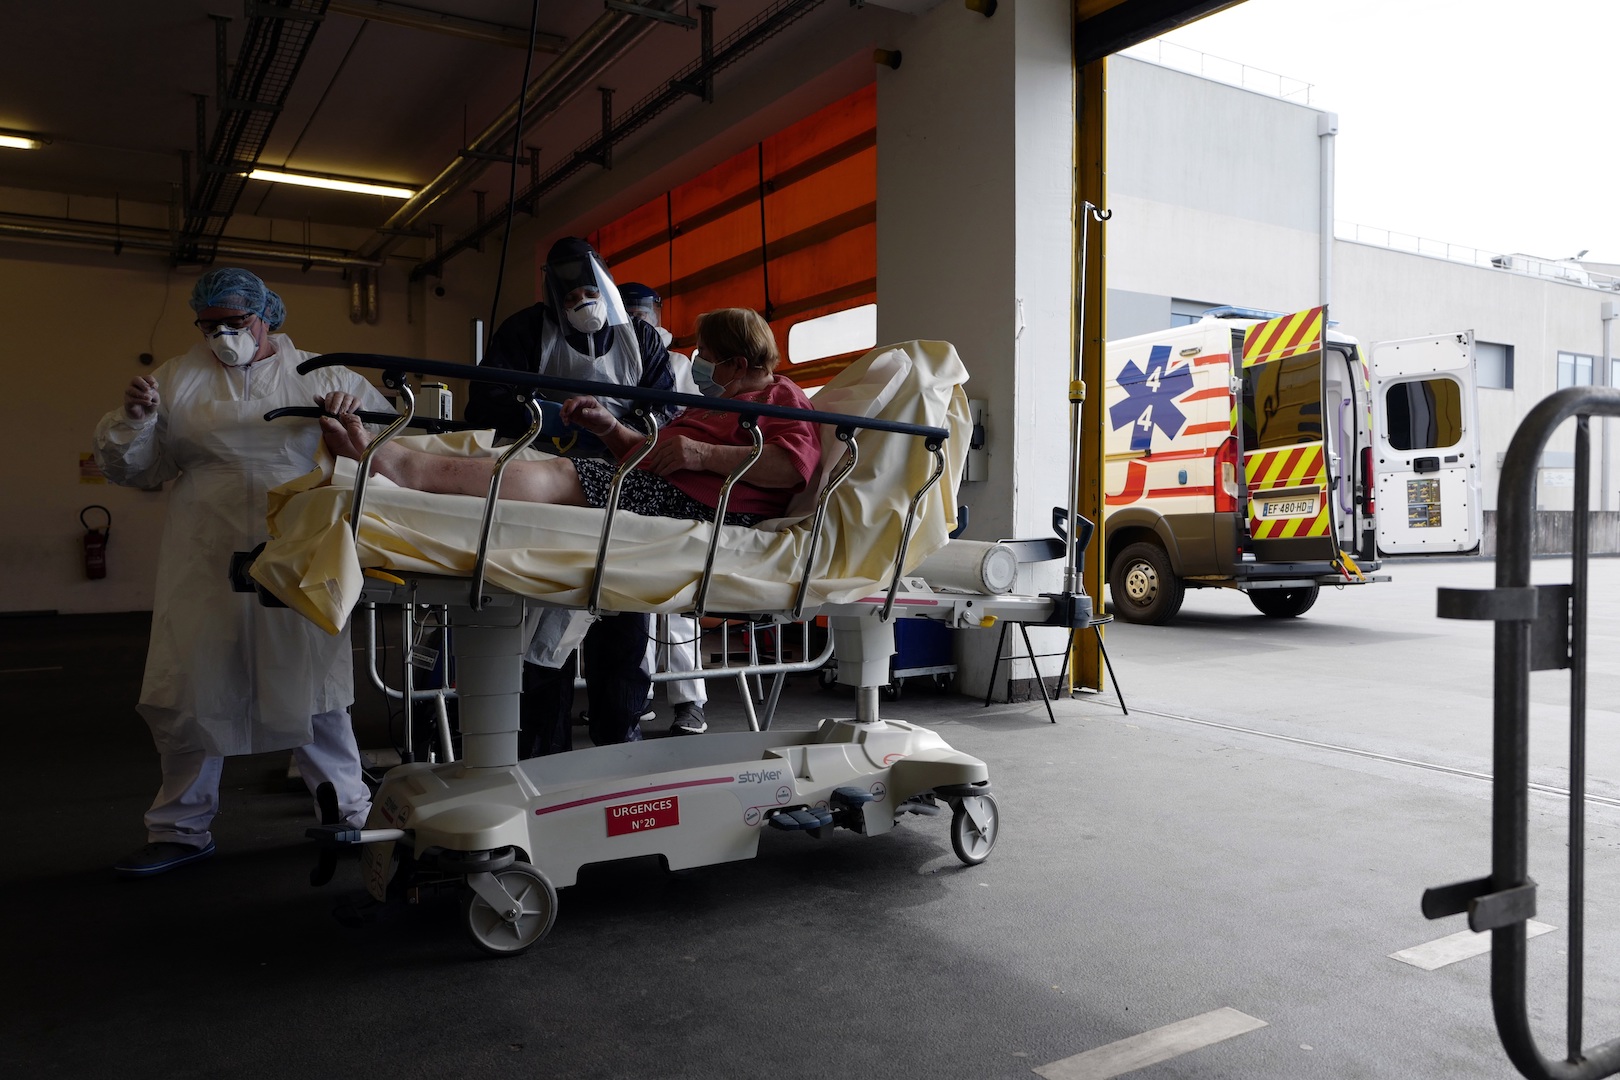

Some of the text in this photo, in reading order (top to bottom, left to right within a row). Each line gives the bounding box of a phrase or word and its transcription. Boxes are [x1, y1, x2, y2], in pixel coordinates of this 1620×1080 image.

[1145, 366, 1161, 393] 4
[1137, 404, 1153, 432] 4
[738, 769, 782, 784] stryker
[613, 799, 672, 818] URGENCES
